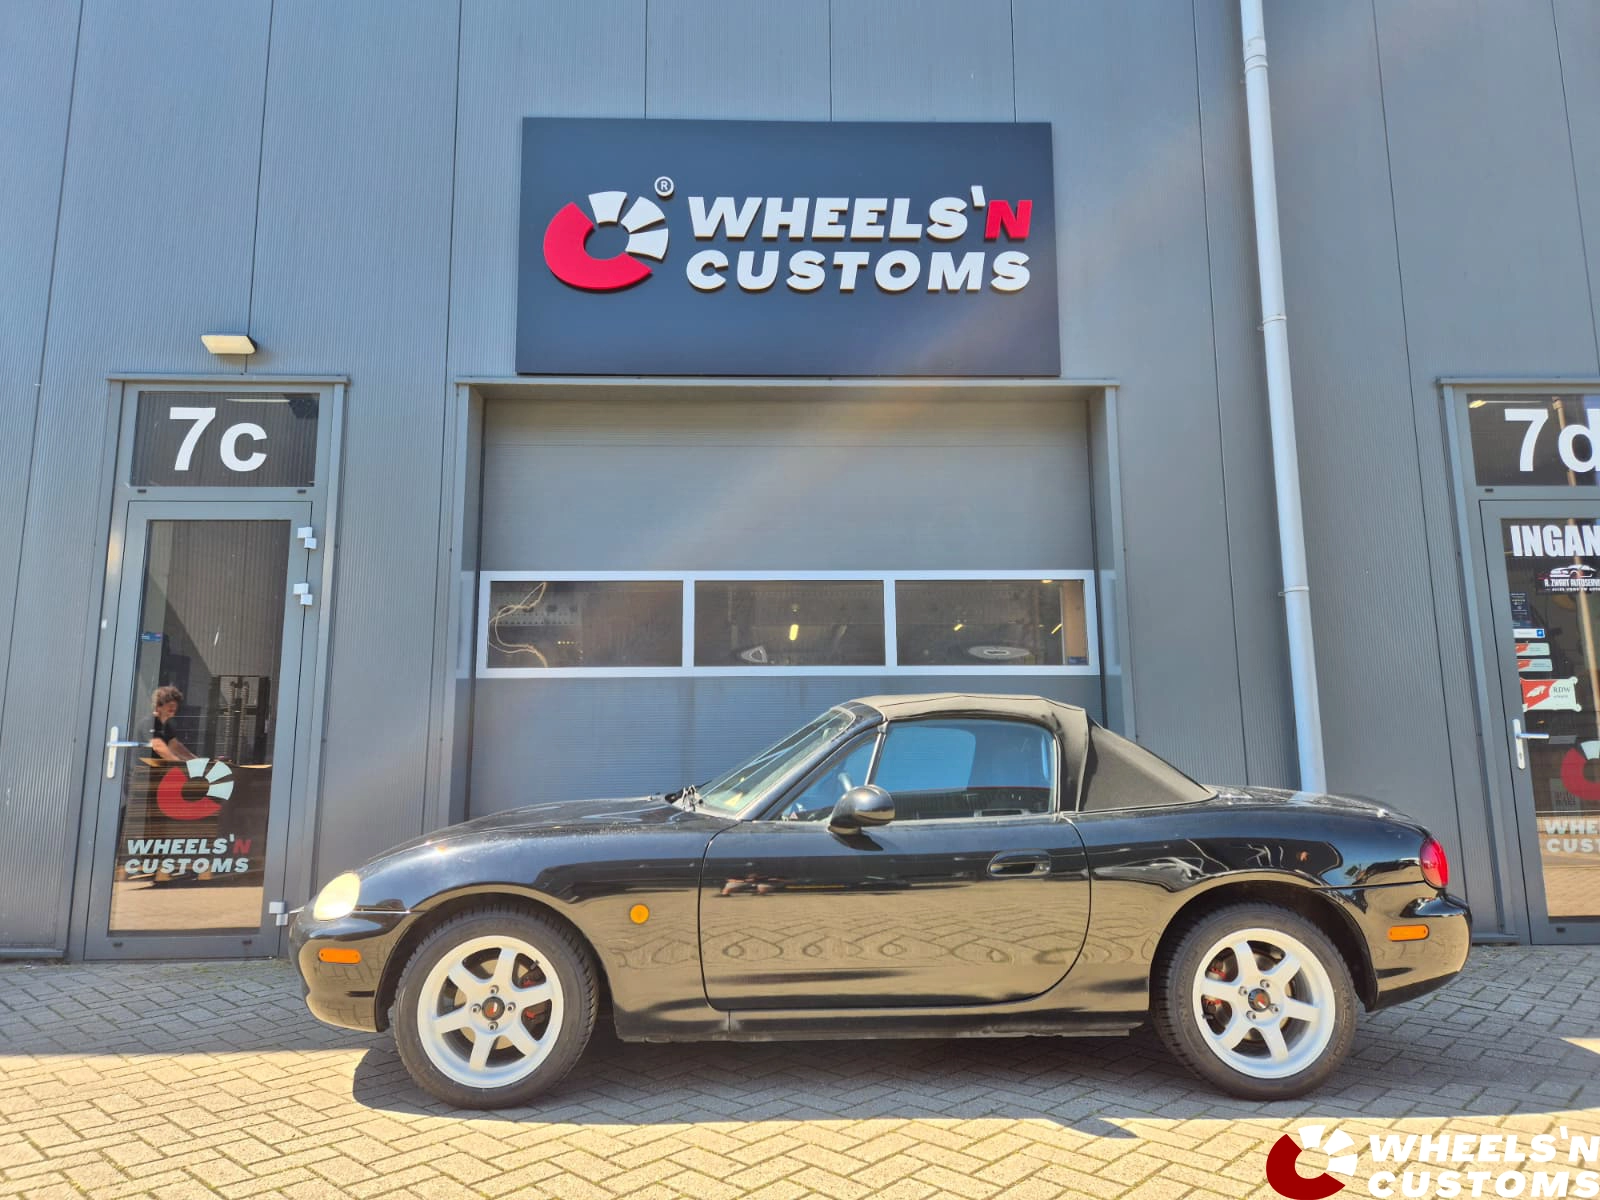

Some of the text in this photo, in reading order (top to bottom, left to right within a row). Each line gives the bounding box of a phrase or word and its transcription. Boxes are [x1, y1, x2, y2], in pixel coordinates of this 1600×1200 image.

[687, 185, 1033, 239] WHEELS'N
[686, 249, 1031, 291] CUSTOMS
[169, 407, 268, 472] 7c
[1504, 408, 1600, 473] 7d
[125, 857, 249, 874] CUSTOMS
[127, 833, 252, 855] WHEELS'N
